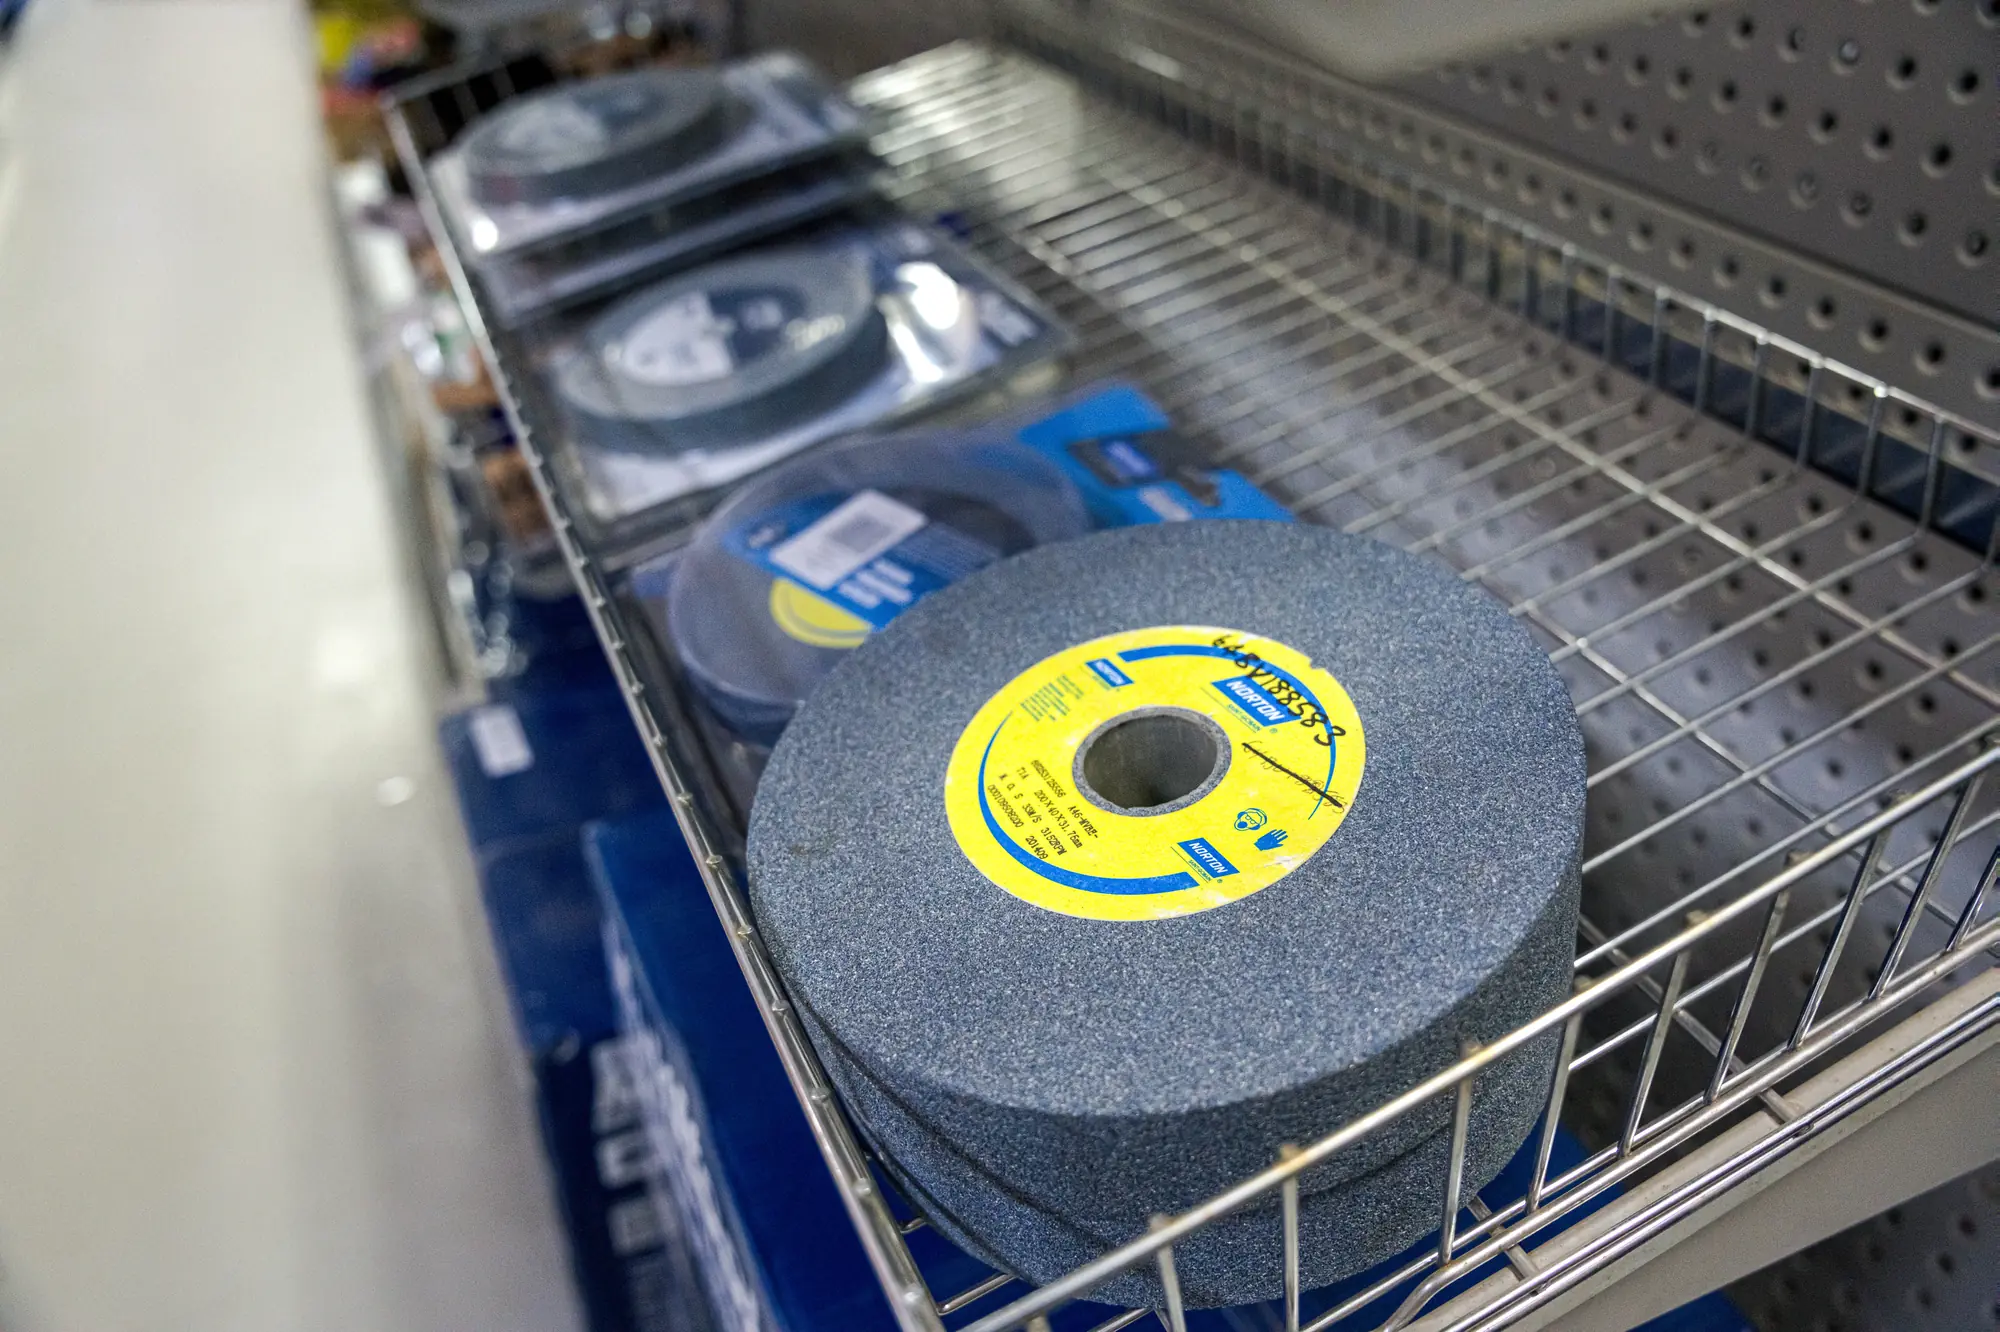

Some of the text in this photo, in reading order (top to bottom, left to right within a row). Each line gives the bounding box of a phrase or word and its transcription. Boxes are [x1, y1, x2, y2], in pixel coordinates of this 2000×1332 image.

[1226, 680, 1285, 721] NORTON
[1025, 835, 1048, 860] 201409
[1188, 842, 1228, 873] NORTON
